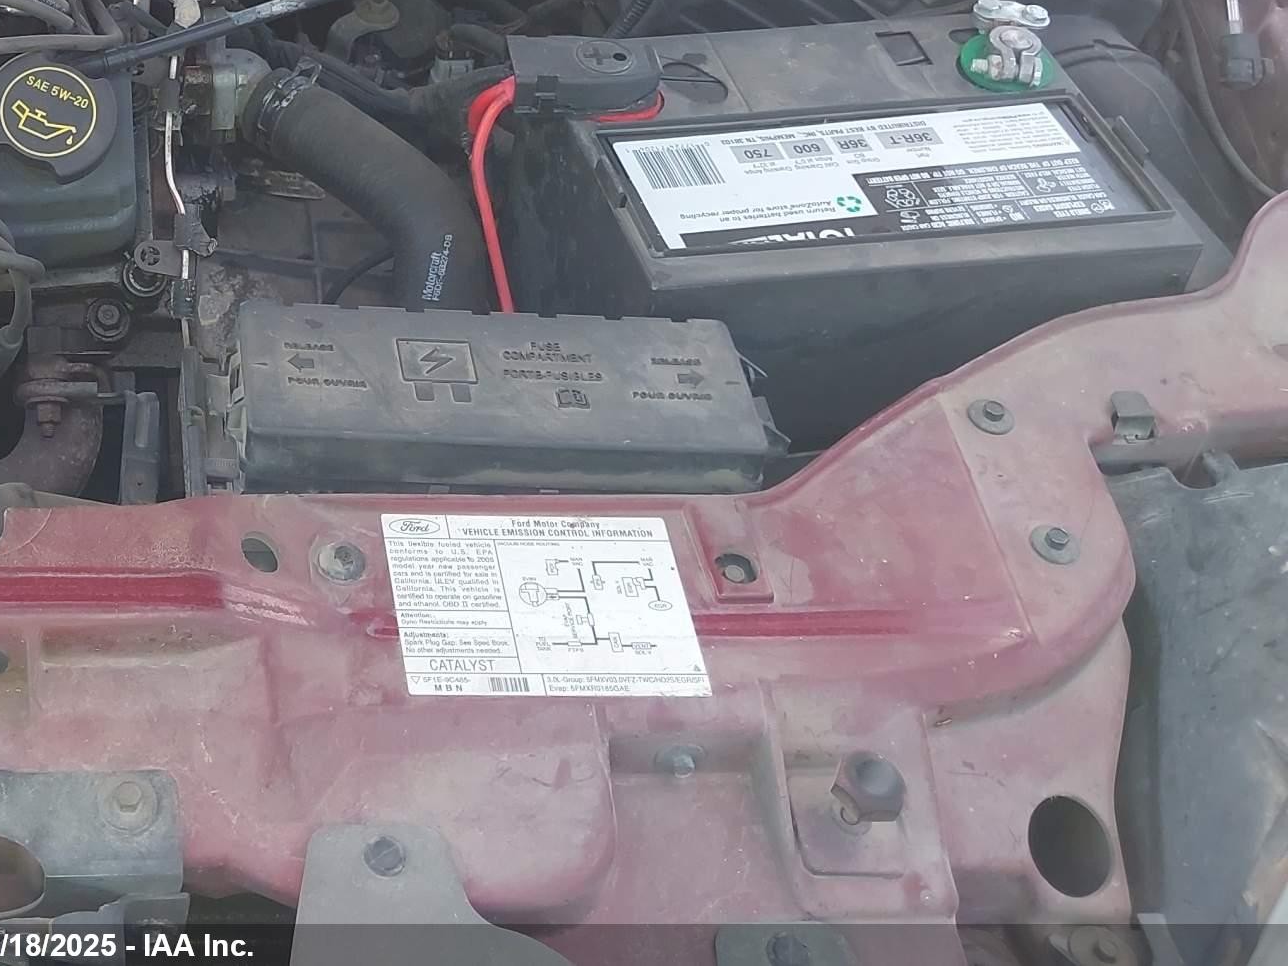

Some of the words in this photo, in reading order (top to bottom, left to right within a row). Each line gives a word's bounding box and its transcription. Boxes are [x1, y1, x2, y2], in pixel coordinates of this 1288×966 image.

[26, 76, 50, 92] SAE
[50, 86, 88, 108] 5W-20
[877, 121, 926, 130] DISTRIBUTED
[888, 132, 932, 144] 36R-T
[793, 143, 820, 154] 600
[837, 139, 868, 150] 36R
[744, 148, 772, 159] 750
[680, 210, 719, 220] recycling
[722, 206, 750, 216] proper
[744, 210, 781, 220] batteries
[806, 206, 836, 214] Return
[422, 252, 442, 300] Motorcraft
[530, 342, 560, 352] FUSE
[502, 350, 592, 362] COMPARTMENT
[632, 391, 665, 400] POUR
[400, 520, 430, 532] Ford
[511, 520, 530, 528] Ford
[533, 520, 558, 528] Motor
[561, 520, 600, 530] Company
[462, 528, 498, 536] VEHICLE
[501, 529, 546, 537] EMISSION
[548, 529, 590, 538] CONTROL
[592, 530, 653, 538] INFORMATION
[429, 659, 495, 671] CATALYST
